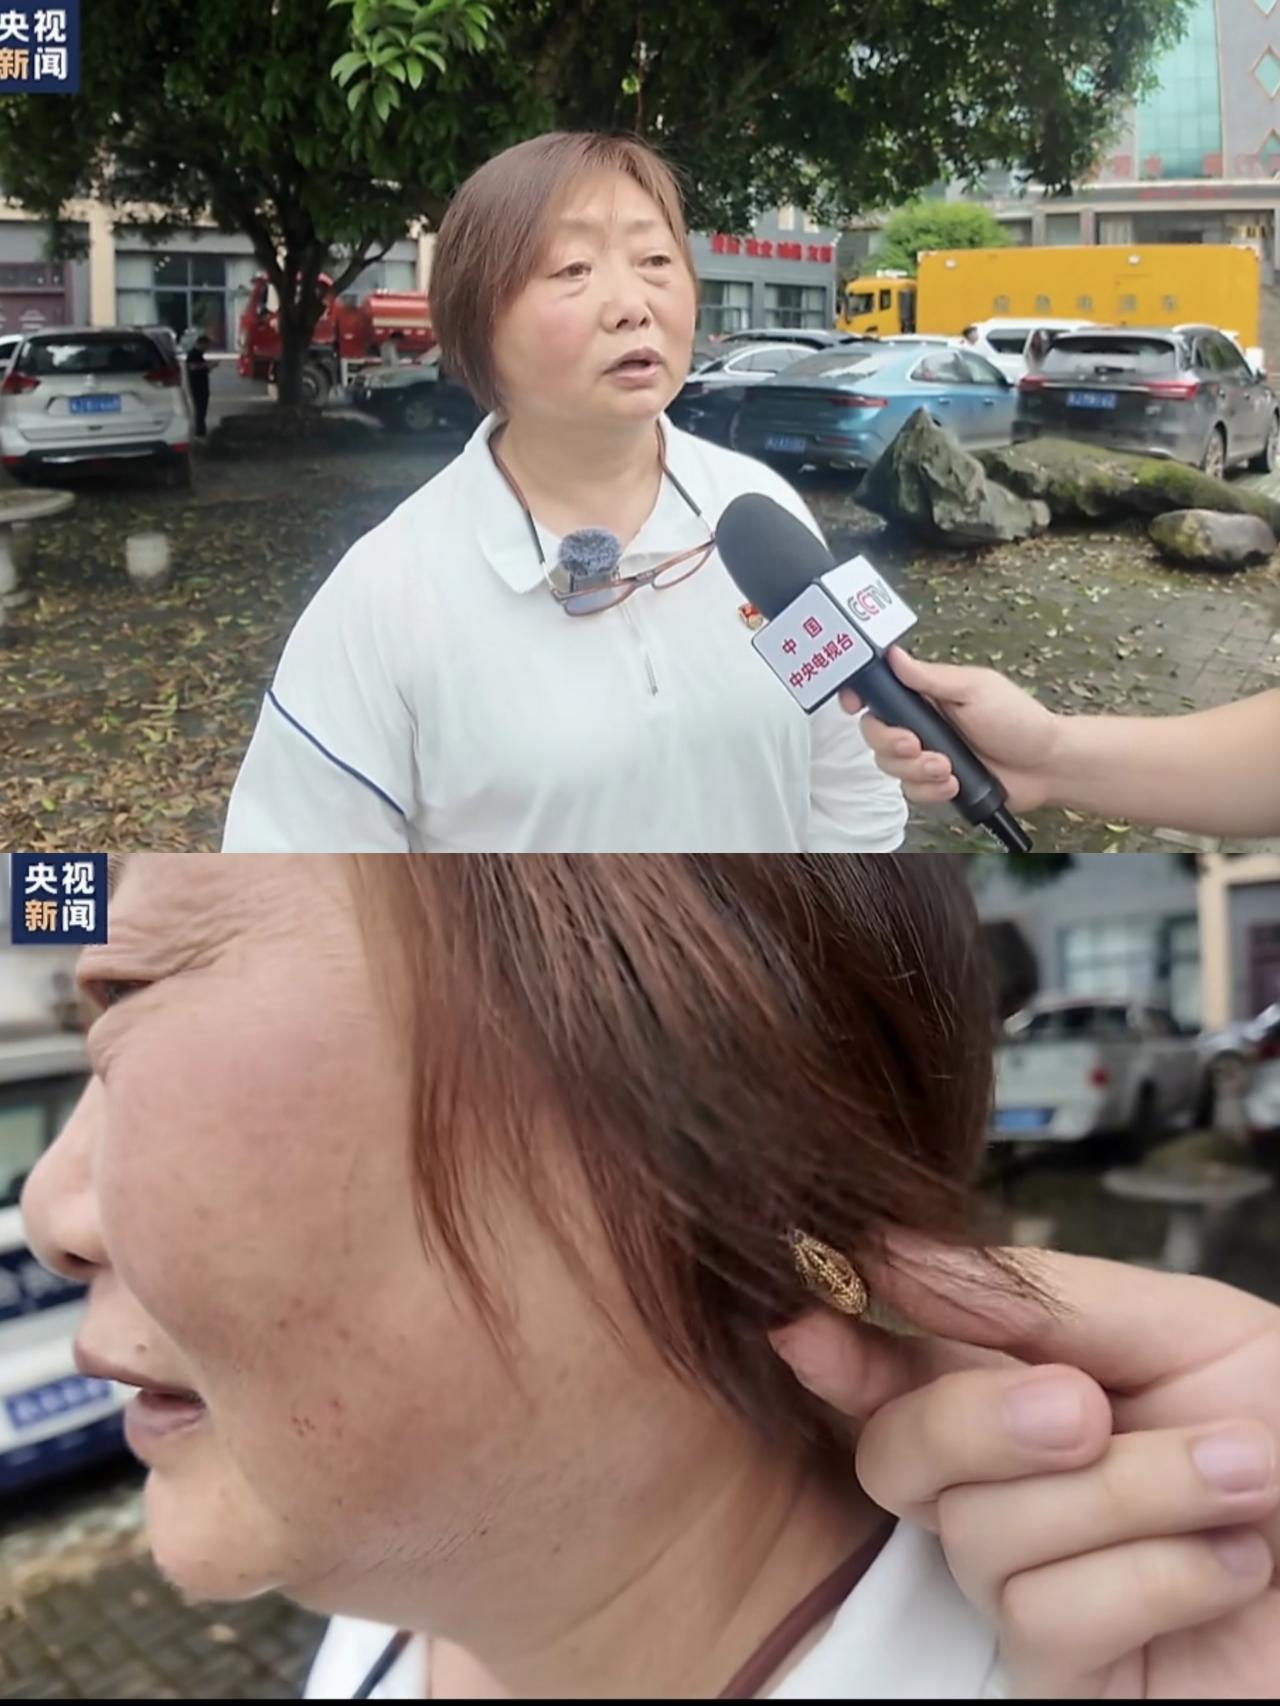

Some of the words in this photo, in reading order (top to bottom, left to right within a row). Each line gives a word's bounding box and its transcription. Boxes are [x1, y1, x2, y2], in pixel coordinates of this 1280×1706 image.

[847, 579, 892, 621] CCTV
[789, 632, 854, 688] 中央电视台
